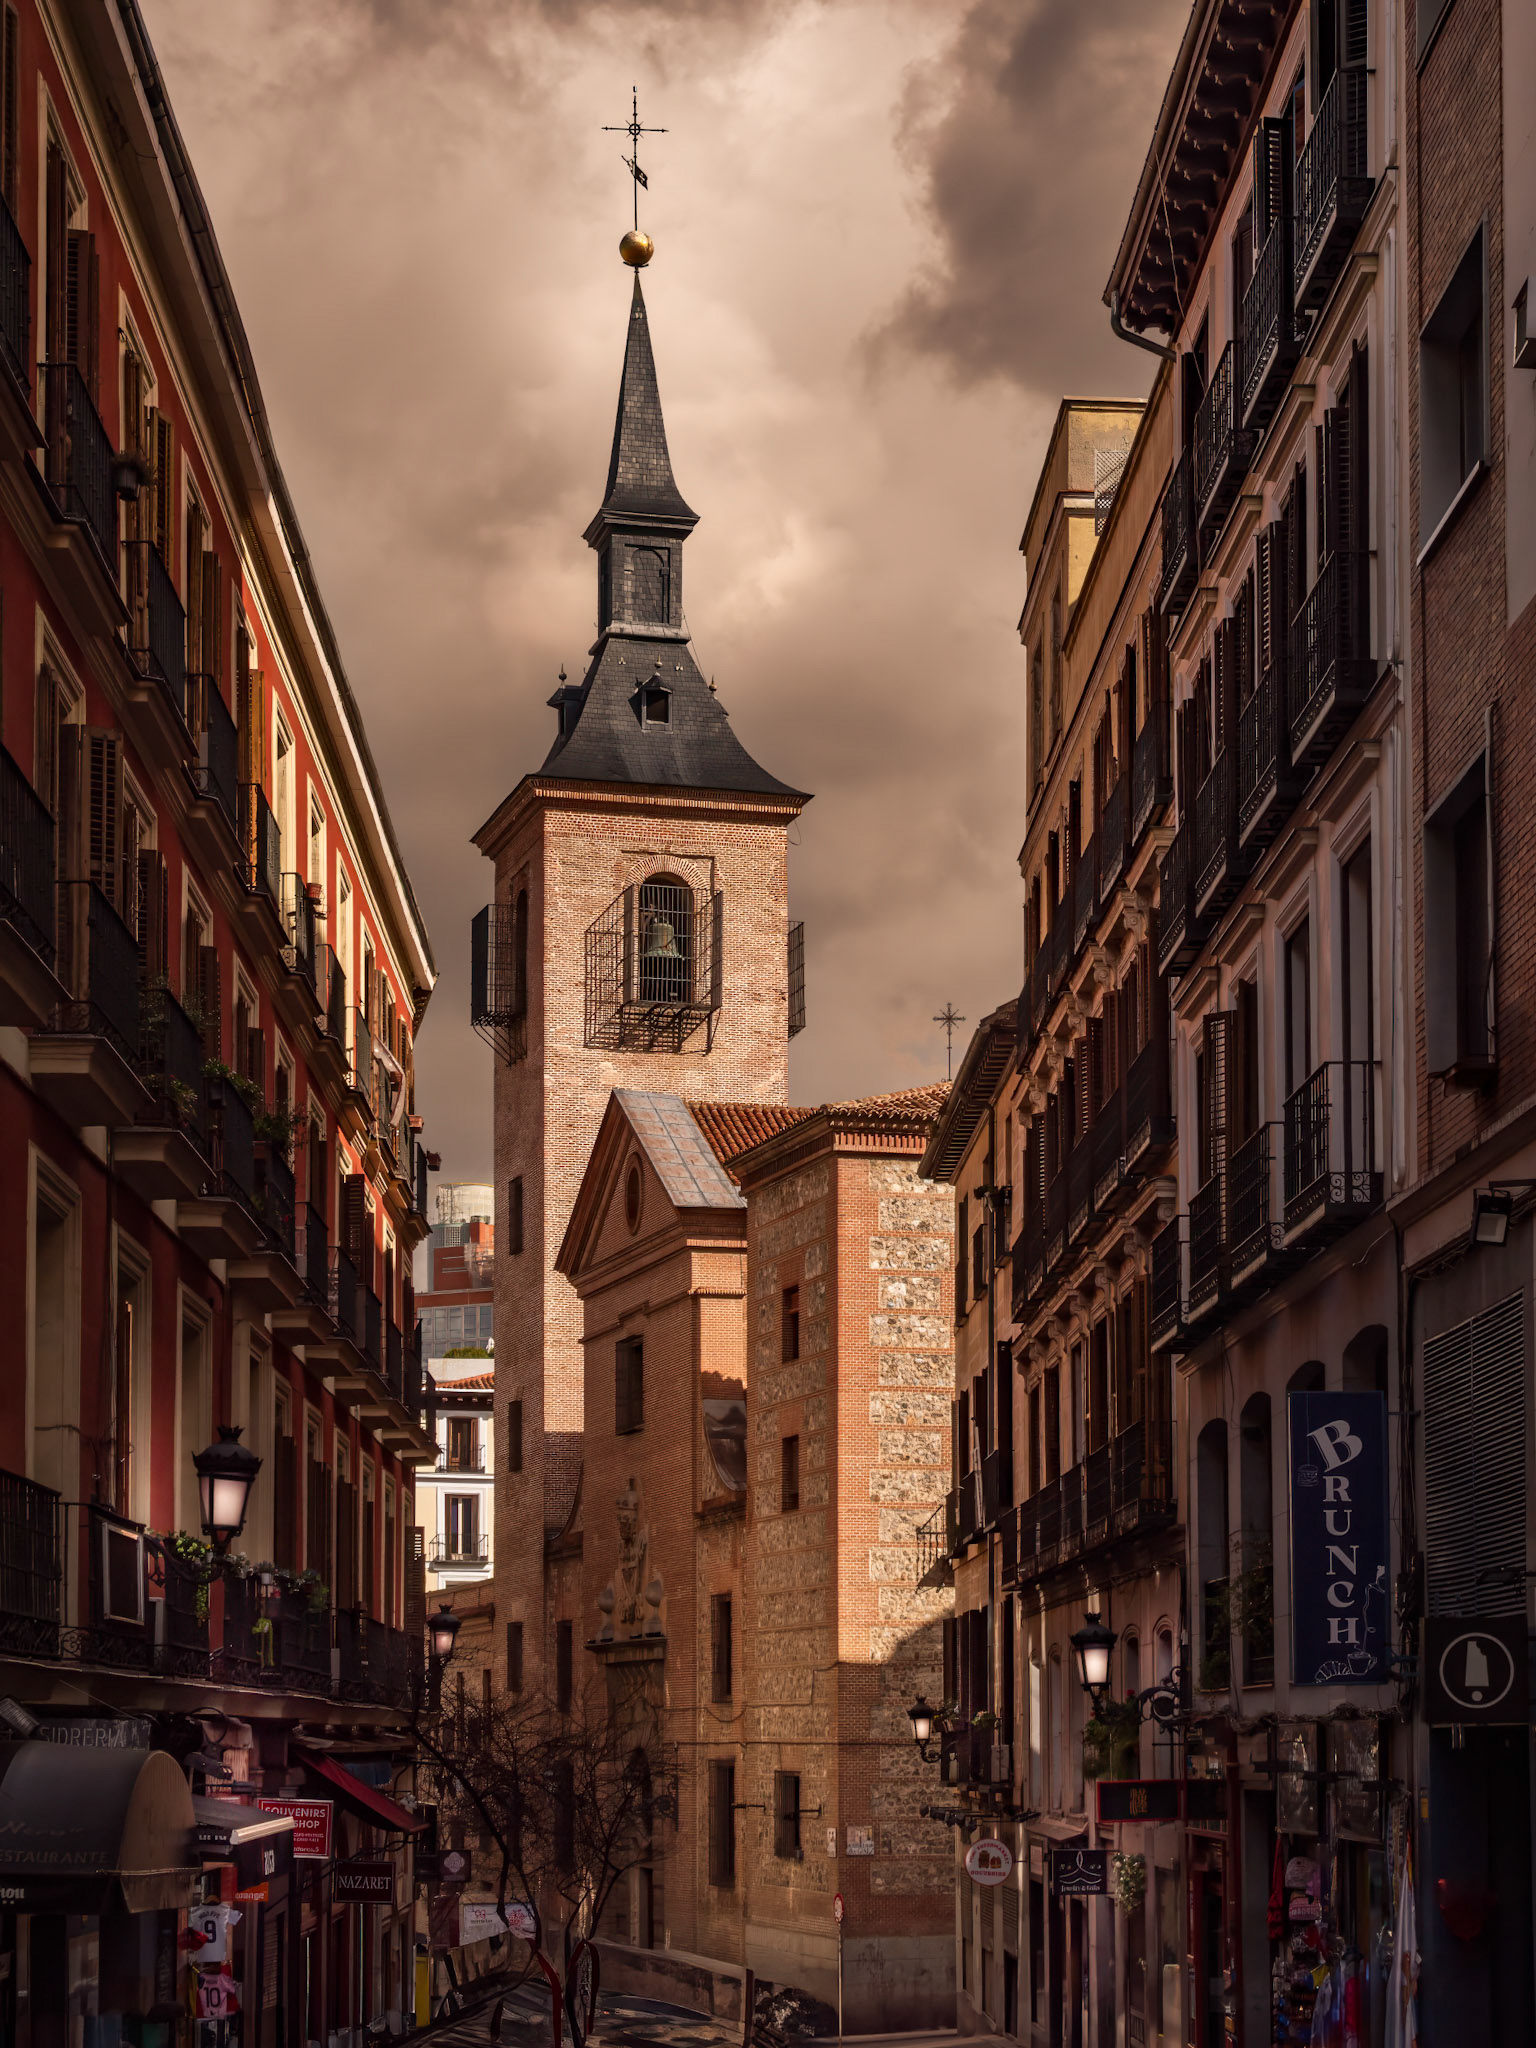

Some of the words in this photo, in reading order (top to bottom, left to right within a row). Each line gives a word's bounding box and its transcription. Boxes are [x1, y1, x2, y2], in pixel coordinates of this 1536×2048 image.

[1307, 1419, 1363, 1645] BRUNCH
[265, 1806, 326, 1818] SOUVENIRS
[294, 1819, 320, 1829] SHOP
[338, 1875, 392, 1890] NAZARET
[204, 1920, 217, 1943] 9
[203, 1987, 221, 2013] 10
